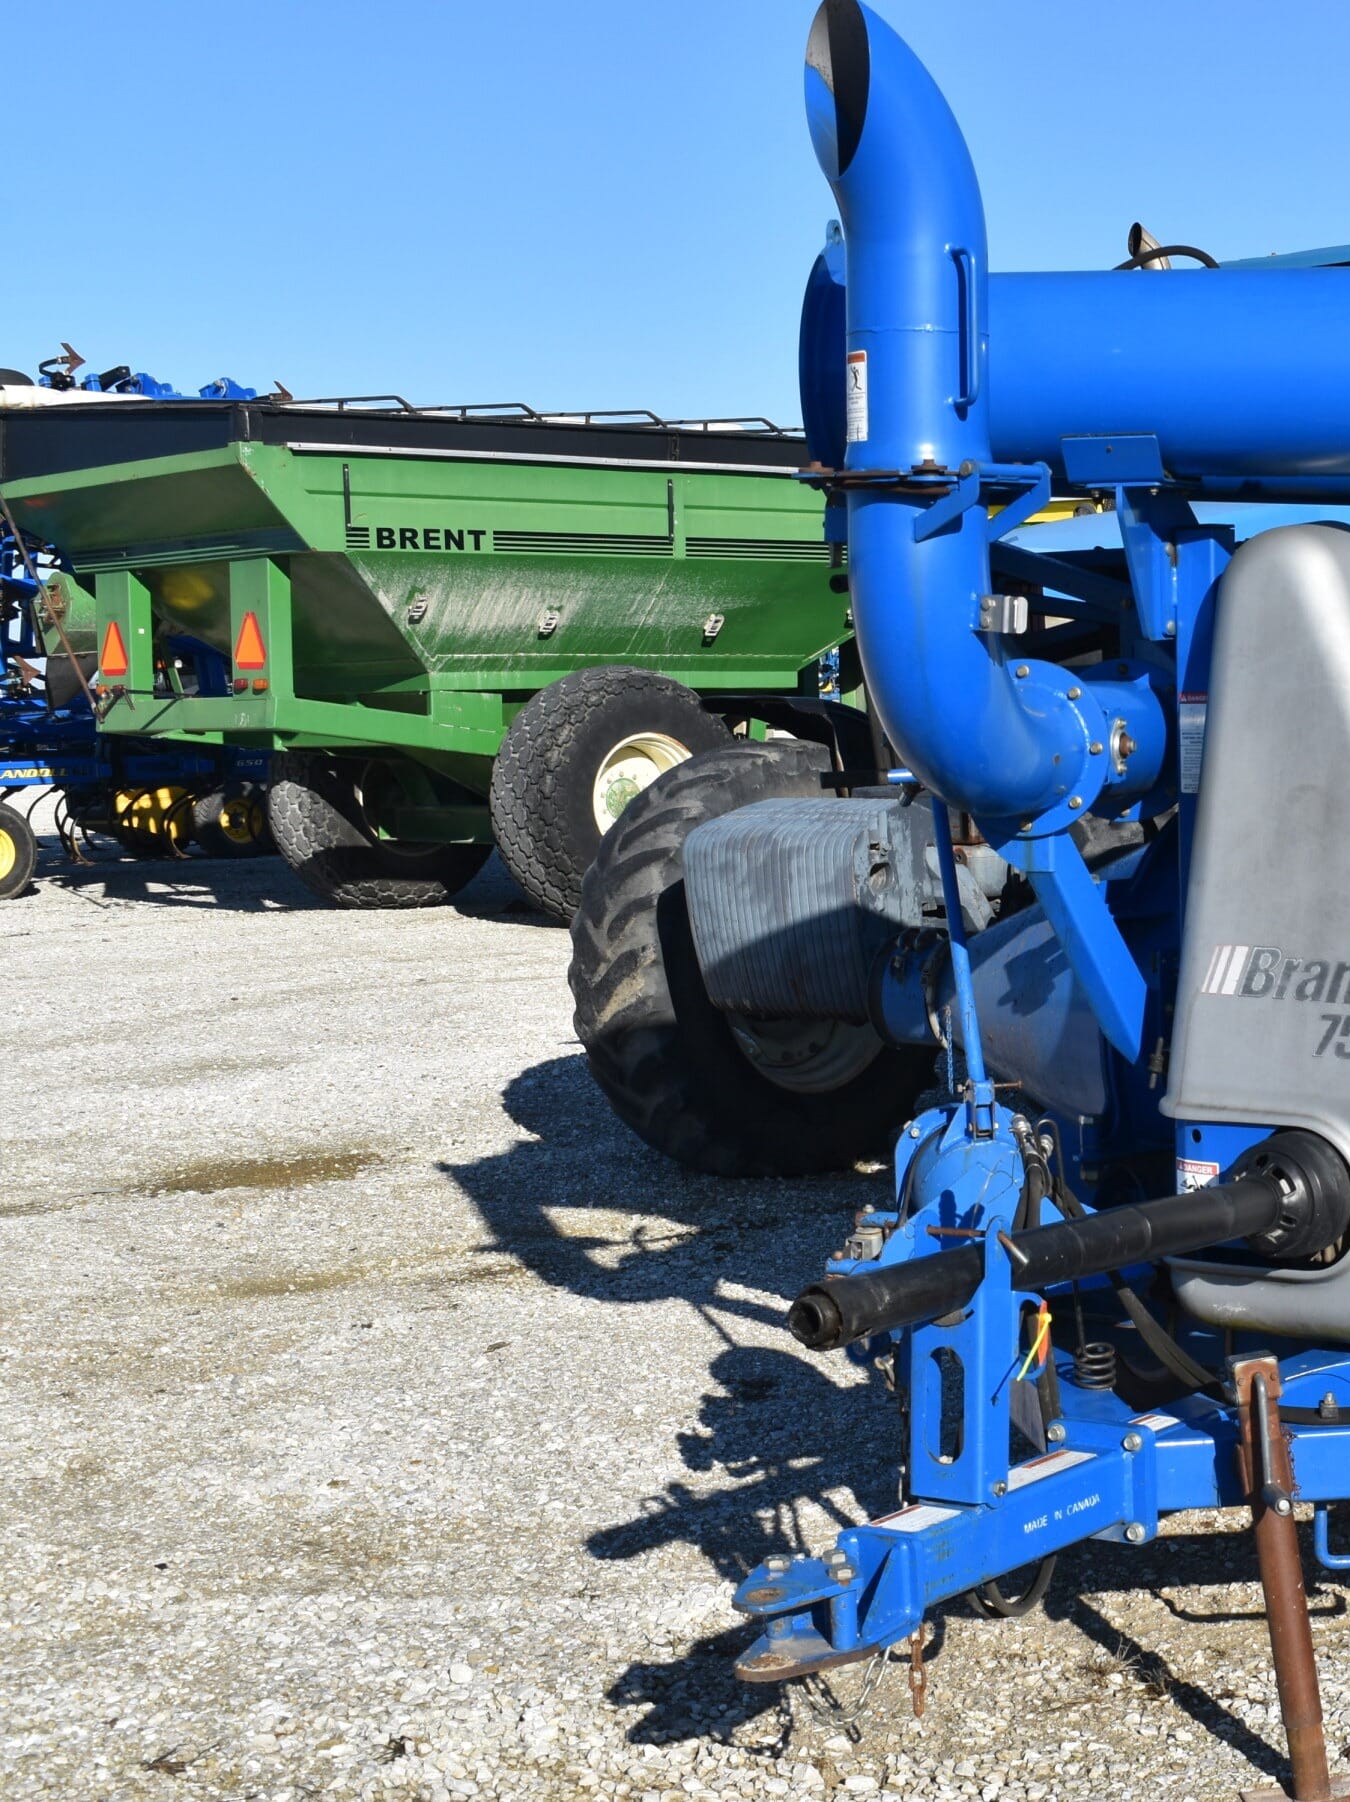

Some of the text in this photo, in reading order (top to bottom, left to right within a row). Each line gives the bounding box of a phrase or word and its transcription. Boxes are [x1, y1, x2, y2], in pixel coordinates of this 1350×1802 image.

[376, 527, 486, 551] BRENT
[1184, 1163, 1213, 1174] DANGER
[1023, 1493, 1101, 1534] MADE IN CANADA
